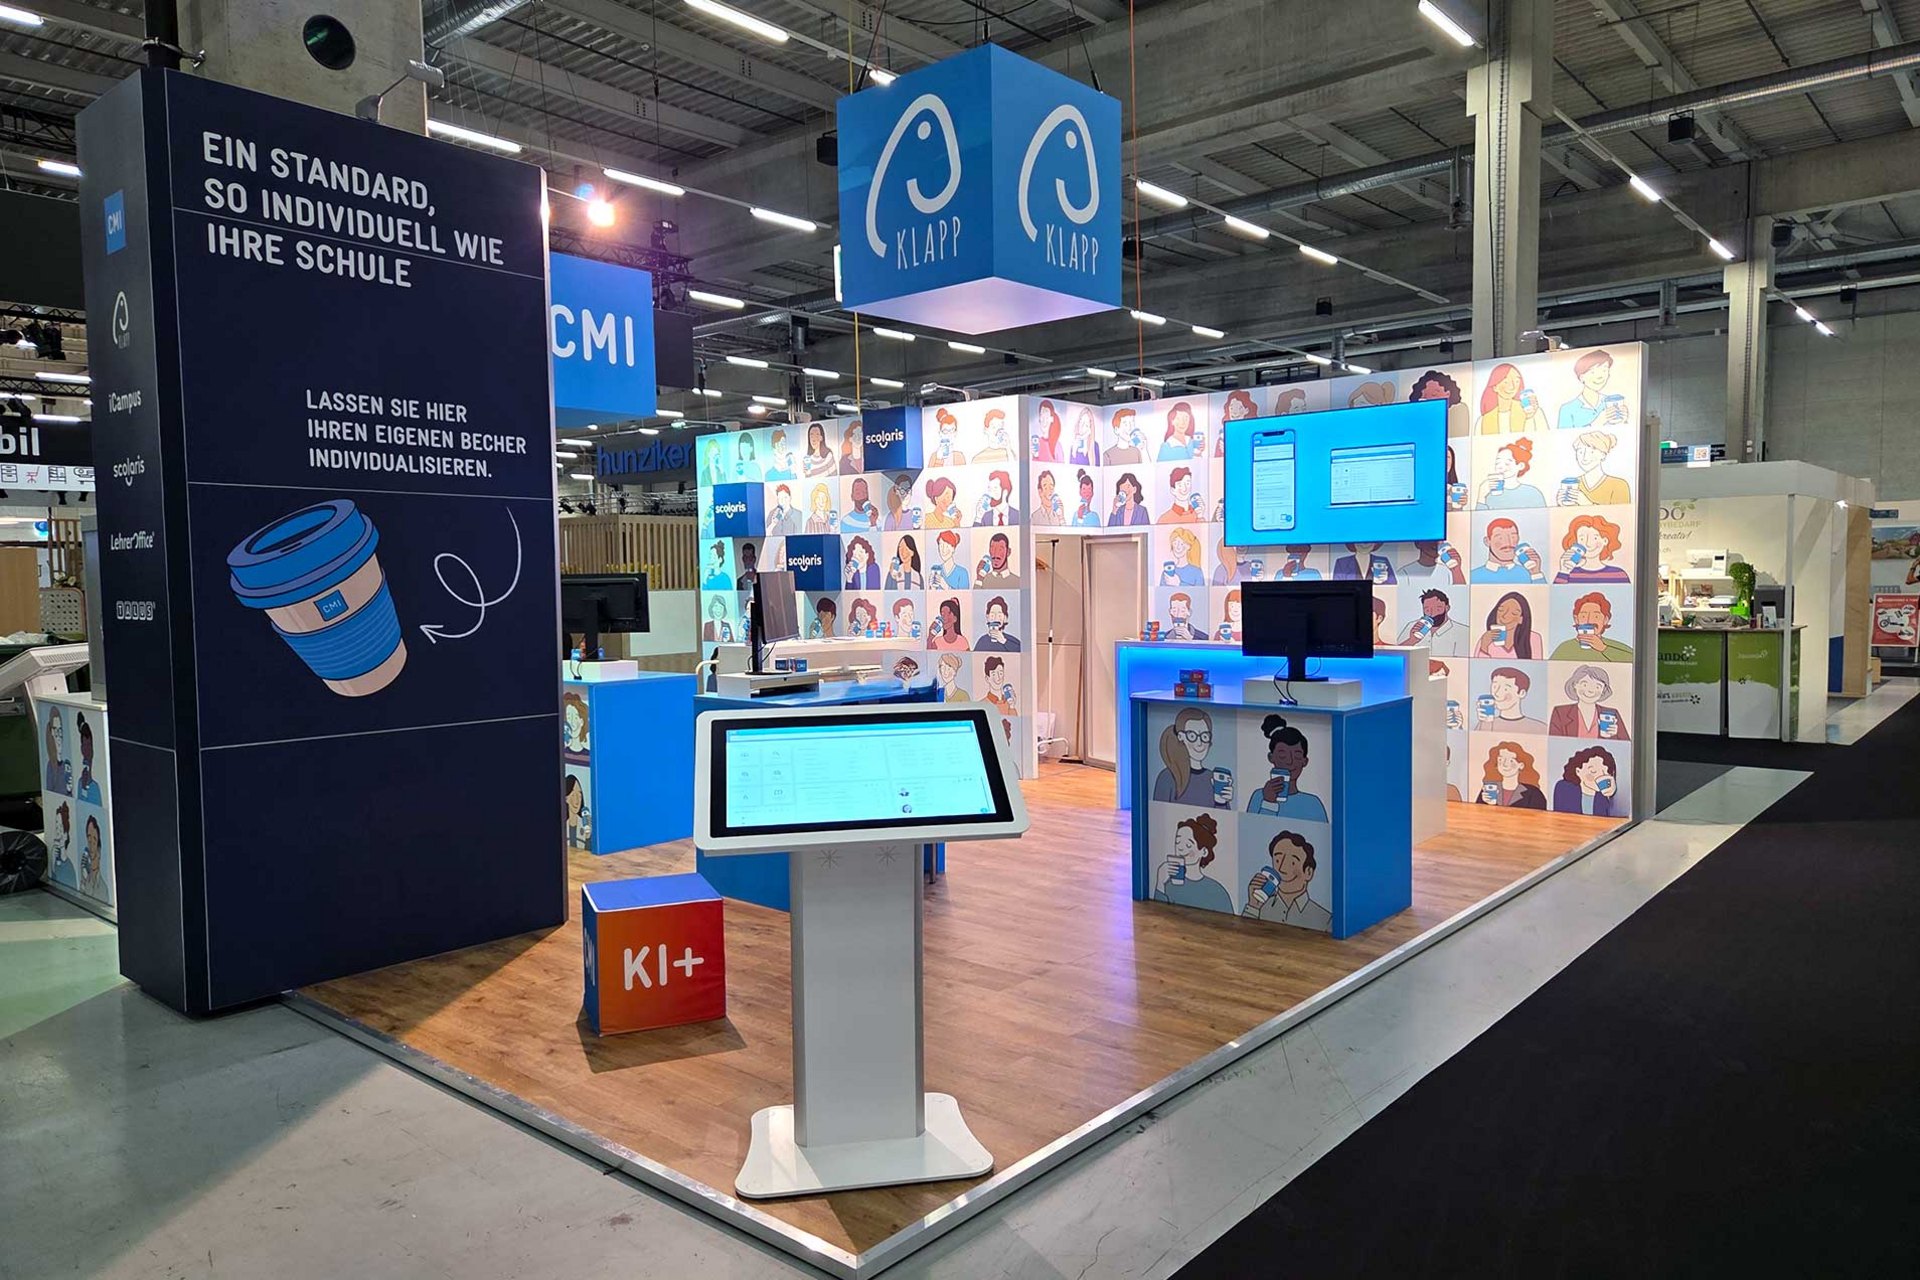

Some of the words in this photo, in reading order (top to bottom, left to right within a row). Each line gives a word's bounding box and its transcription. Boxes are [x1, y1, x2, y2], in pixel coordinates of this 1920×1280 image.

[203, 131, 257, 172] EIN
[270, 148, 435, 217] STANDARD,
[108, 210, 122, 235] CMI
[204, 178, 248, 214] SO
[261, 189, 446, 254] INDIVIDUELL
[453, 230, 504, 266] WIE
[207, 222, 285, 266] IHRE
[295, 240, 412, 288] SCHULE
[897, 216, 961, 270] KLAPP
[1046, 223, 1099, 275] KLAPP
[551, 303, 635, 367] CMI
[108, 390, 142, 414] iCampus
[306, 389, 384, 415] LASSEN
[390, 398, 420, 419] SIE
[426, 401, 467, 423] HIER
[307, 418, 368, 442] IHREN
[375, 424, 454, 448] EIGENEN
[460, 431, 527, 455] BECHER
[865, 428, 905, 449] scolaris
[113, 455, 145, 487] scolaris
[309, 447, 493, 478] INDIVIDUALISIEREN.
[597, 439, 692, 476] hunziker
[715, 501, 747, 519] scolaris
[788, 554, 822, 572] scolaris
[322, 599, 342, 613] CMI
[623, 943, 705, 991] KI+
